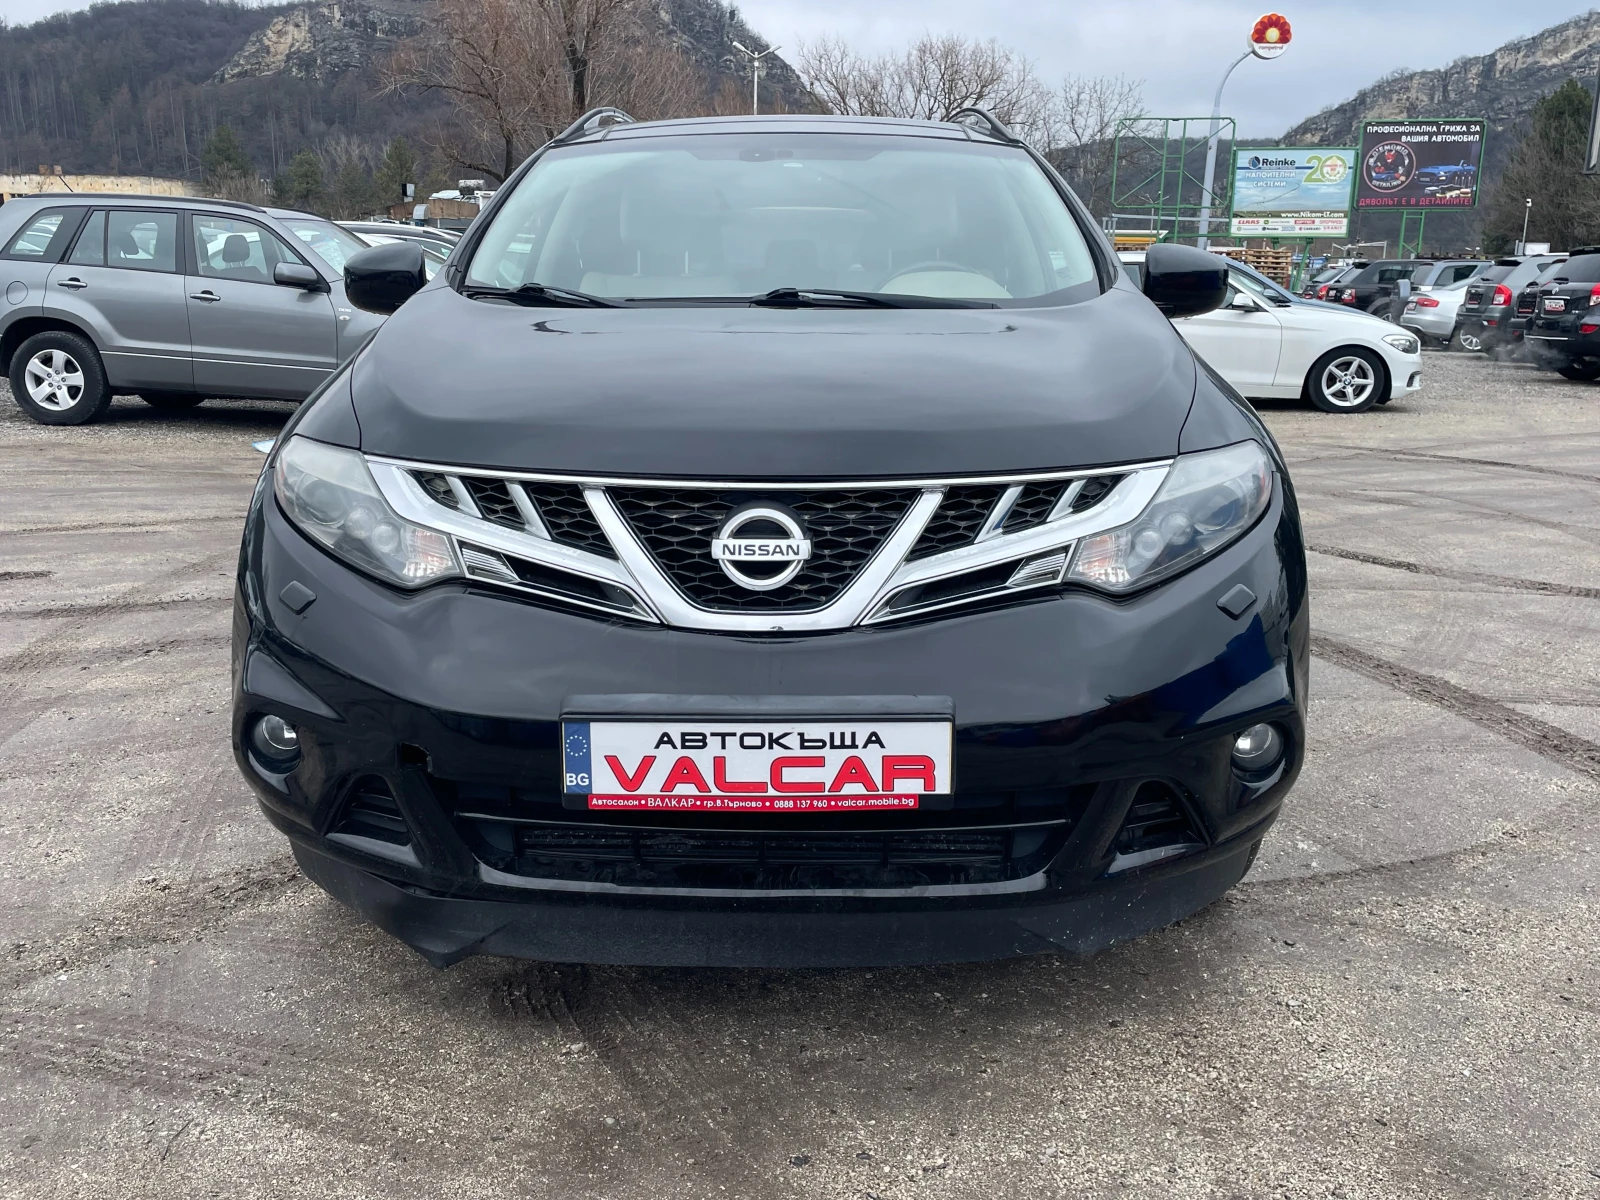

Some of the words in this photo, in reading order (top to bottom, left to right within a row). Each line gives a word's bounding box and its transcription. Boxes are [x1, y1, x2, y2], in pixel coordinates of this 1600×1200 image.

[1367, 125, 1437, 133] ПРОФЕСИОНАЛНА
[1261, 158, 1296, 167] Reinke
[722, 543, 800, 556] NISSAN
[654, 731, 886, 750] АВТОКЪЩА
[566, 773, 590, 786] BG
[604, 755, 936, 793] VALCAR
[591, 798, 639, 806] Автосалон
[647, 798, 695, 808] ВАЛКАР
[774, 800, 794, 808] 0888
[797, 800, 810, 808] 137
[813, 799, 828, 808] 960
[837, 796, 915, 807] valcar.mobile.bg
